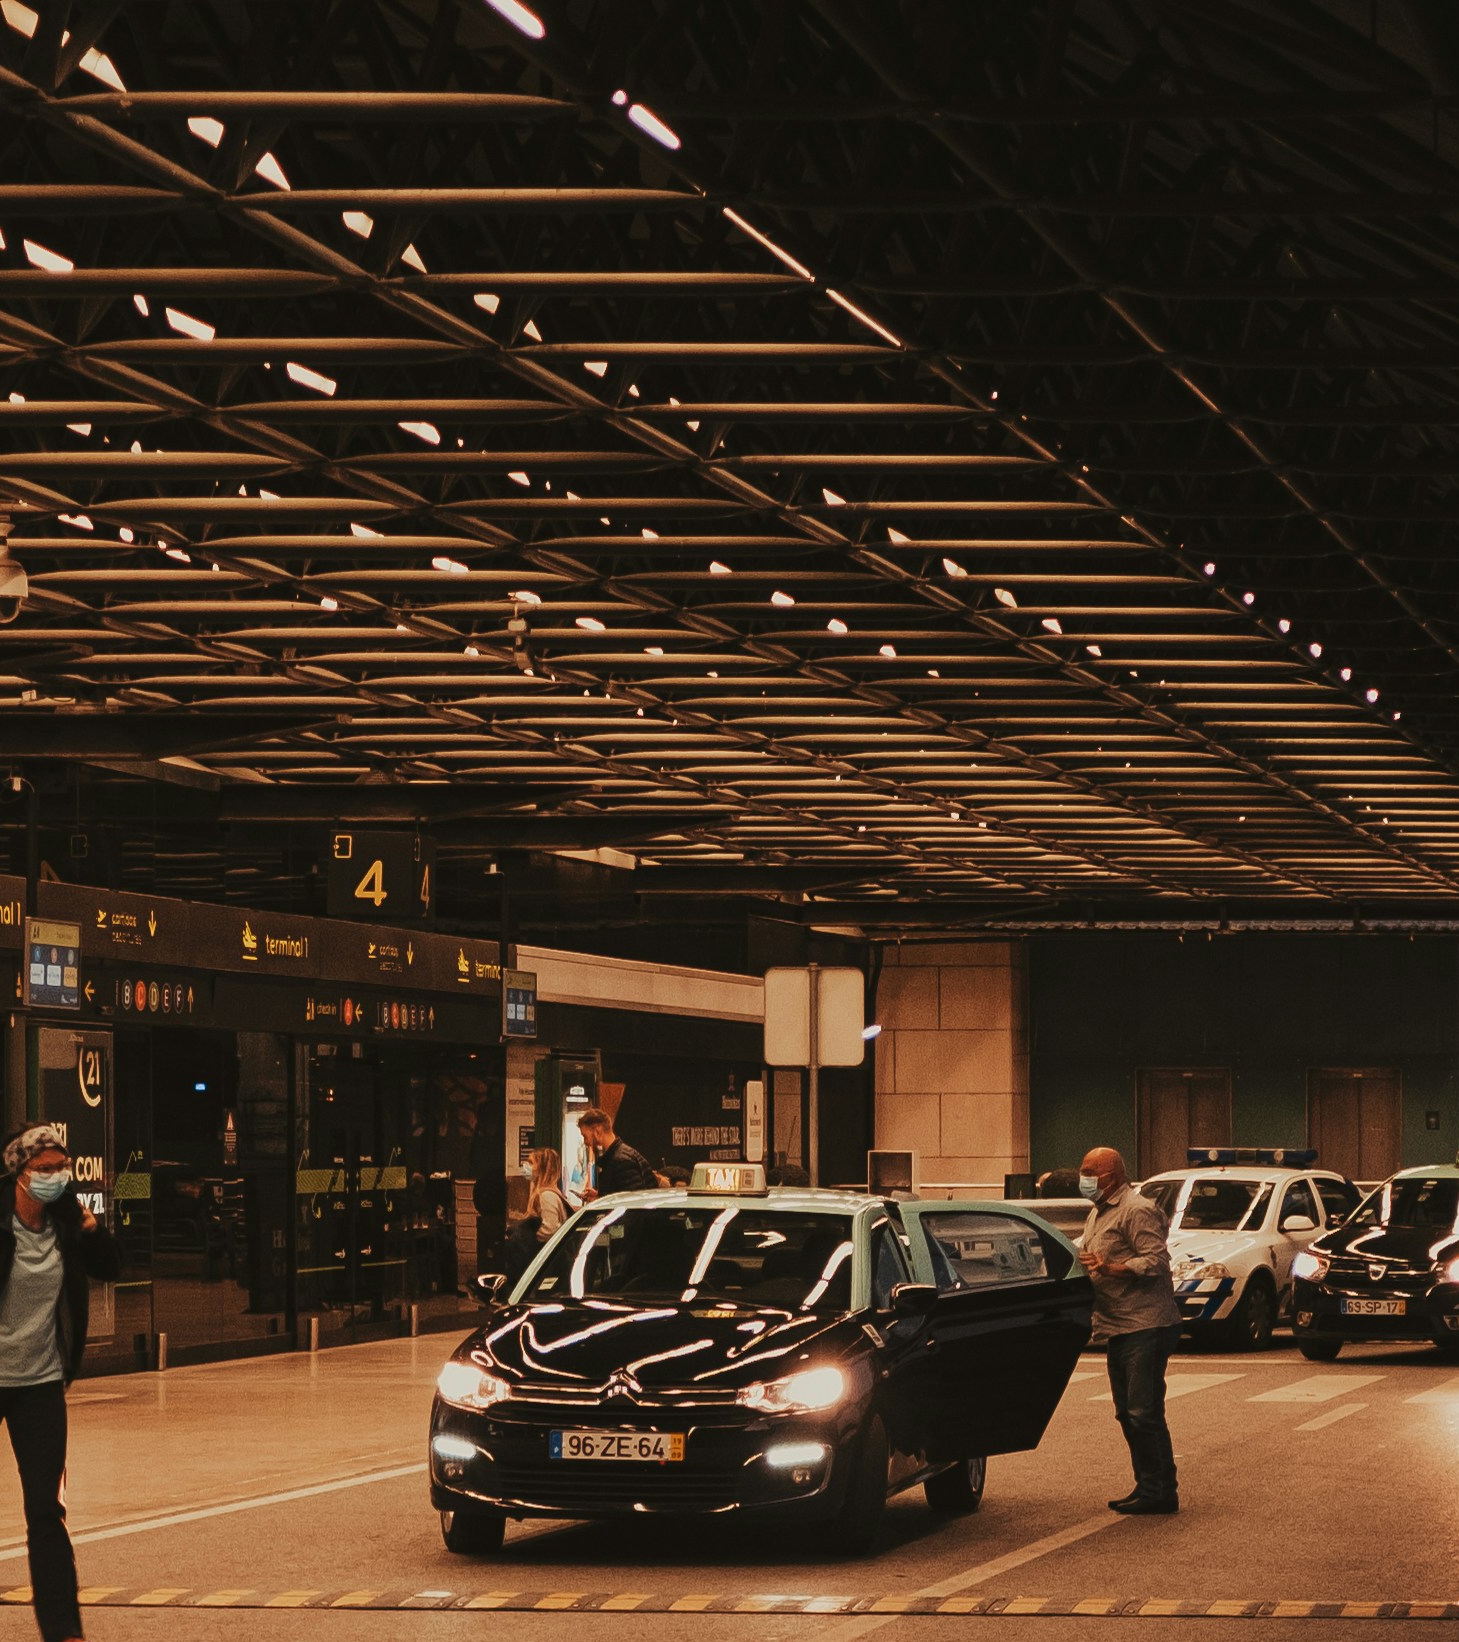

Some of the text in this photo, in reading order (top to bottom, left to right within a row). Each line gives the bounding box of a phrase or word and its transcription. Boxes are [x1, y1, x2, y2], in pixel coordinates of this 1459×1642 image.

[355, 860, 388, 907] 4
[16, 902, 22, 926] 1
[265, 934, 304, 958] terminal
[75, 1156, 103, 1181] COM
[707, 1168, 740, 1191] TAXI
[1347, 1301, 1398, 1313] 69-SP-17
[568, 1435, 665, 1458] 96-ZE-64
